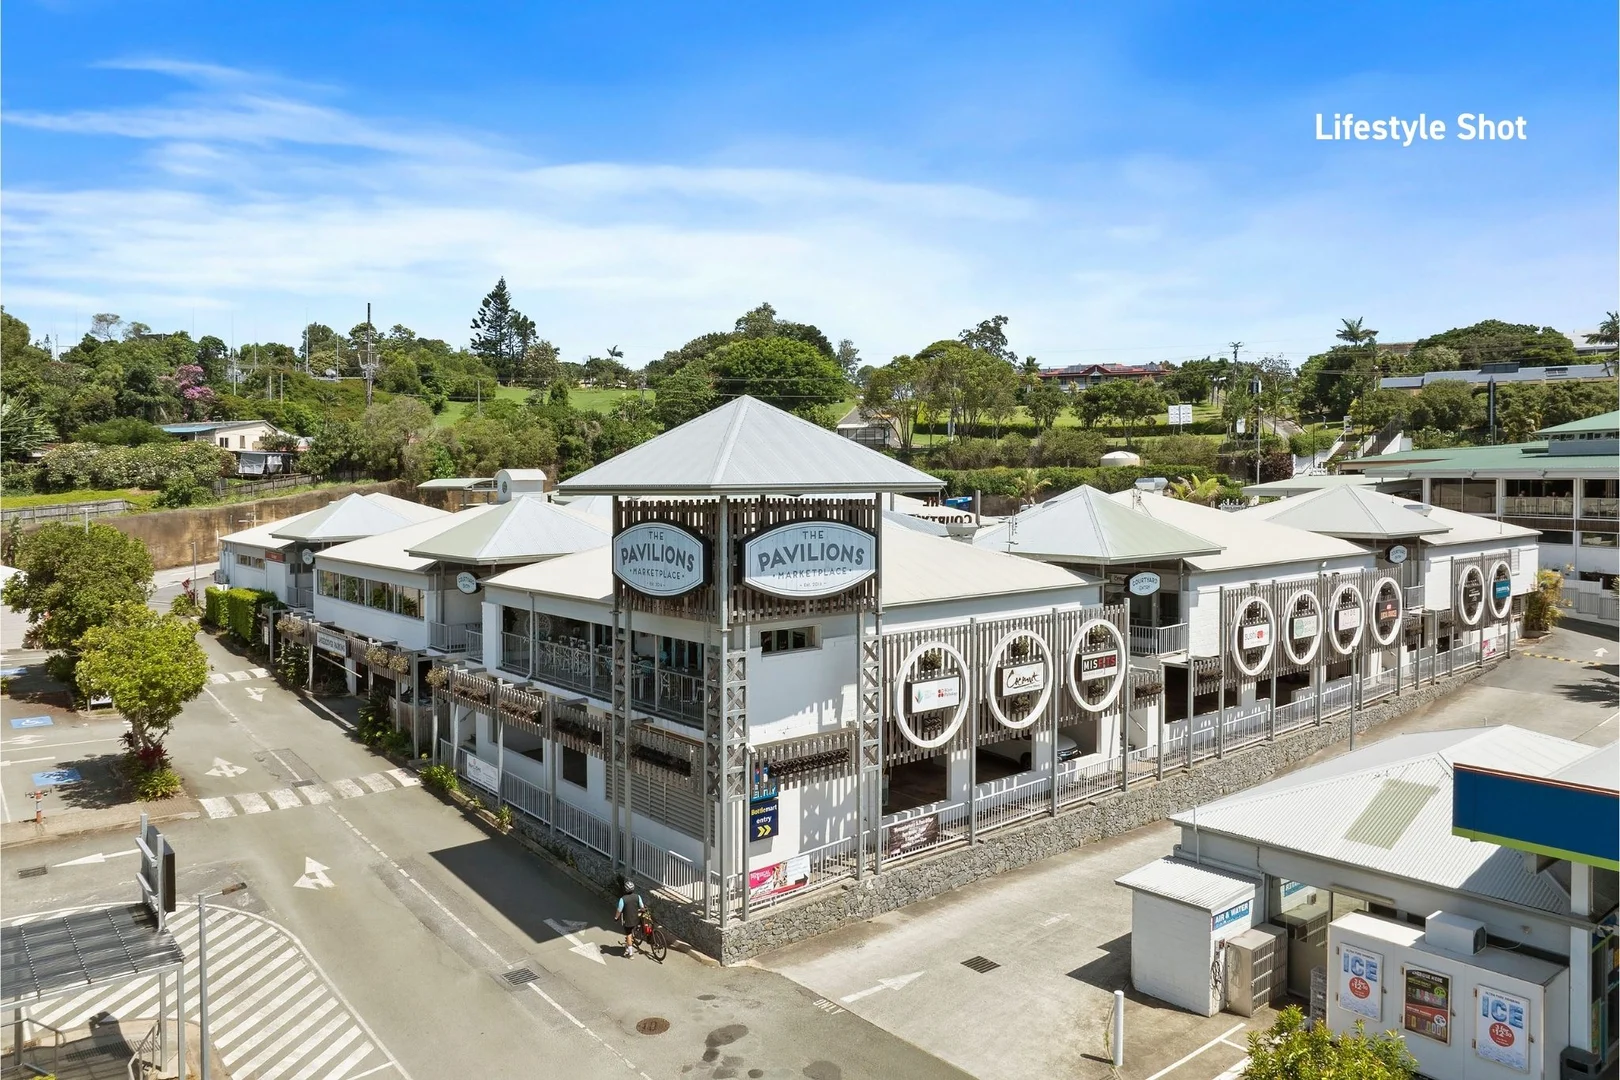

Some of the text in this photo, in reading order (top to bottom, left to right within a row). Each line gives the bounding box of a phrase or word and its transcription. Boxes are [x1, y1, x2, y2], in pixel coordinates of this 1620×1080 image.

[649, 531, 664, 540] THE
[803, 530, 824, 540] THE
[621, 543, 695, 572] PAVILIONS
[758, 543, 865, 572] PAVILIONS
[633, 569, 681, 580] MARKETPLACE
[778, 567, 847, 580] MARKETPLACE
[1132, 577, 1158, 586] COURTYARD
[1083, 654, 1116, 671] MISFITS
[751, 804, 777, 816] Bottlemart
[756, 816, 772, 824] entry
[1215, 914, 1225, 923] AIR
[1231, 902, 1249, 915] WATER
[1343, 952, 1378, 982] ICE
[1482, 995, 1523, 1029] ICE
